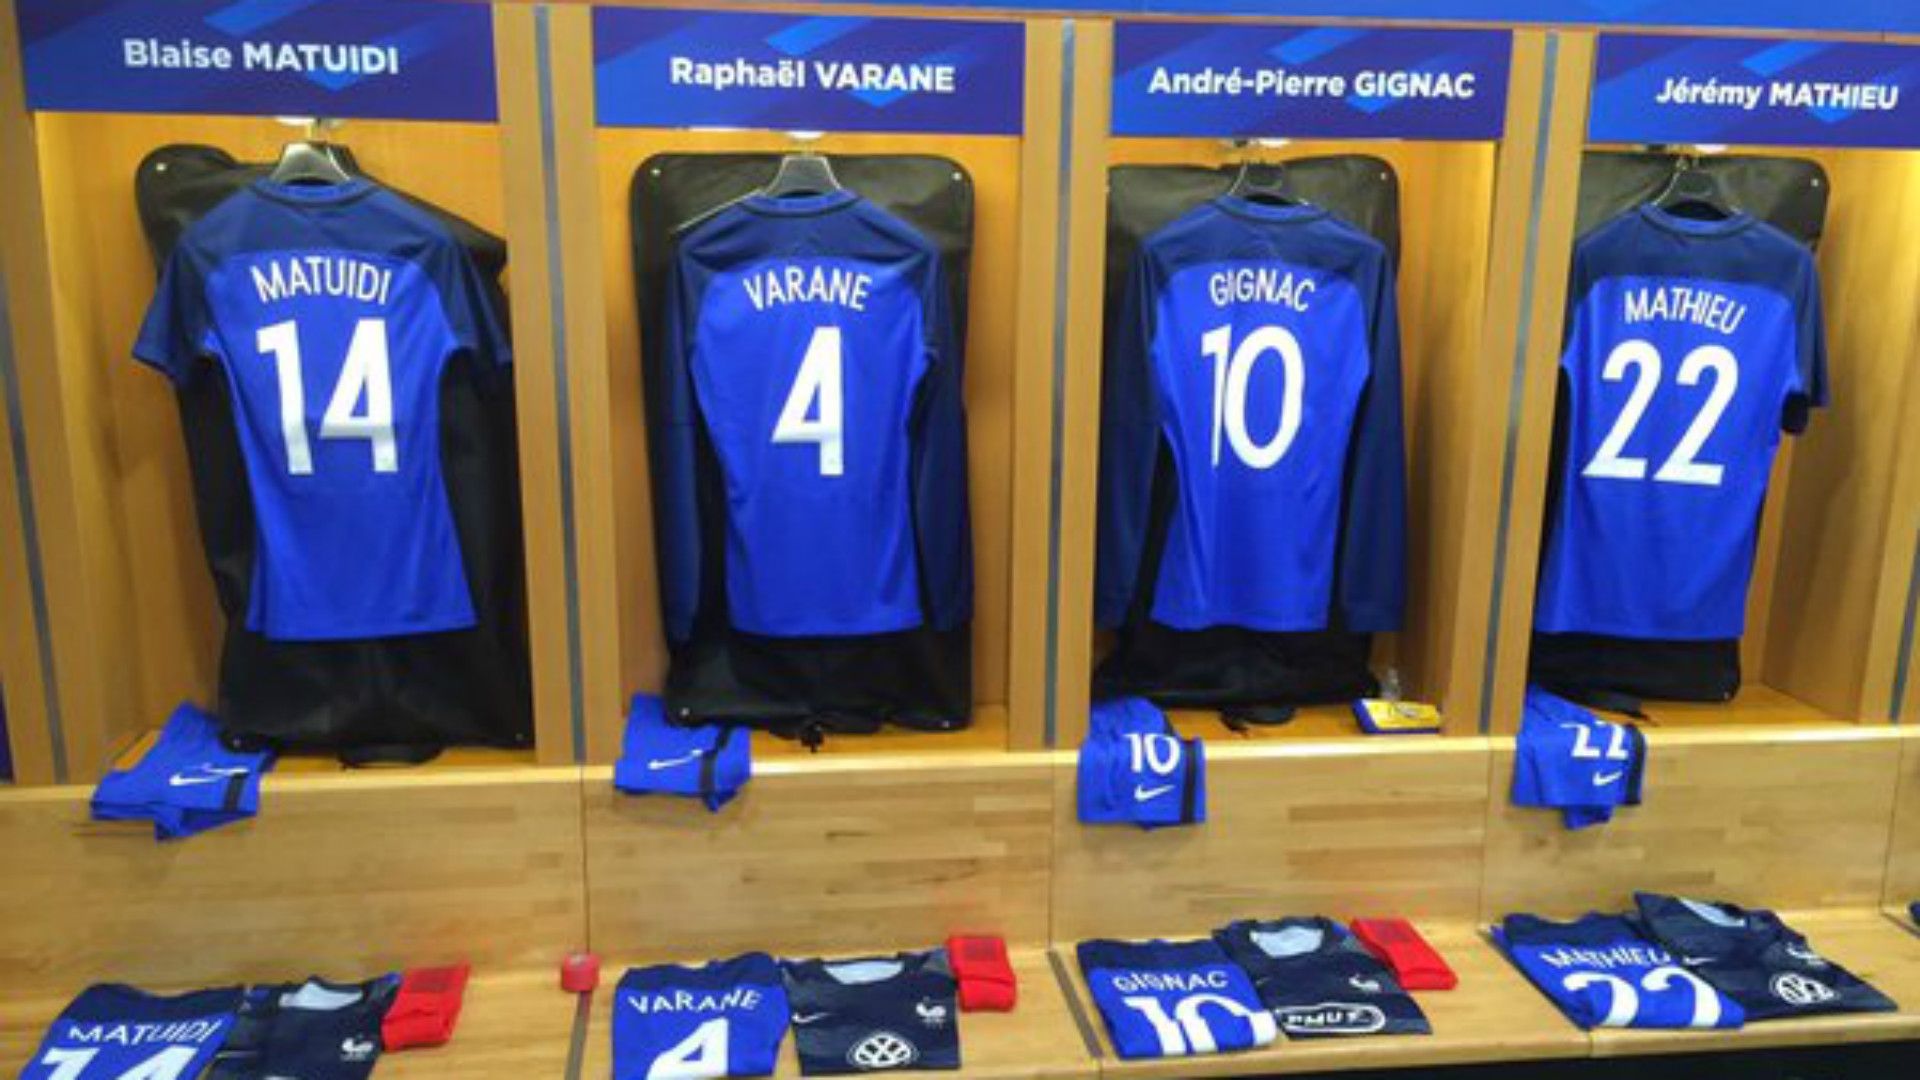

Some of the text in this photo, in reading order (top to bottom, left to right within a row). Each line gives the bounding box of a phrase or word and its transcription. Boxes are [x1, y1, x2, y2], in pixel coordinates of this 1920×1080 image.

[124, 37, 399, 75] Blaise MATUIDI
[670, 56, 955, 93] Raphaël VARANE
[1148, 66, 1476, 99] André-Pierre GIGNAC
[1655, 76, 1899, 110] Jérémy MATHIEU
[250, 254, 393, 305] MATUIDI
[743, 265, 873, 312] VARANE
[1209, 268, 1316, 313] GIGNAC
[1623, 287, 1746, 335] MATHIEU
[255, 318, 398, 474] 14
[771, 325, 844, 476] 4
[1201, 324, 1306, 469] 10
[1582, 339, 1740, 486] 22
[1124, 732, 1182, 775] 10
[628, 987, 762, 1015] VARANE
[1112, 969, 1230, 993] GIGNAC
[68, 1018, 222, 1046] MATUIDI
[646, 1017, 730, 1079] 4
